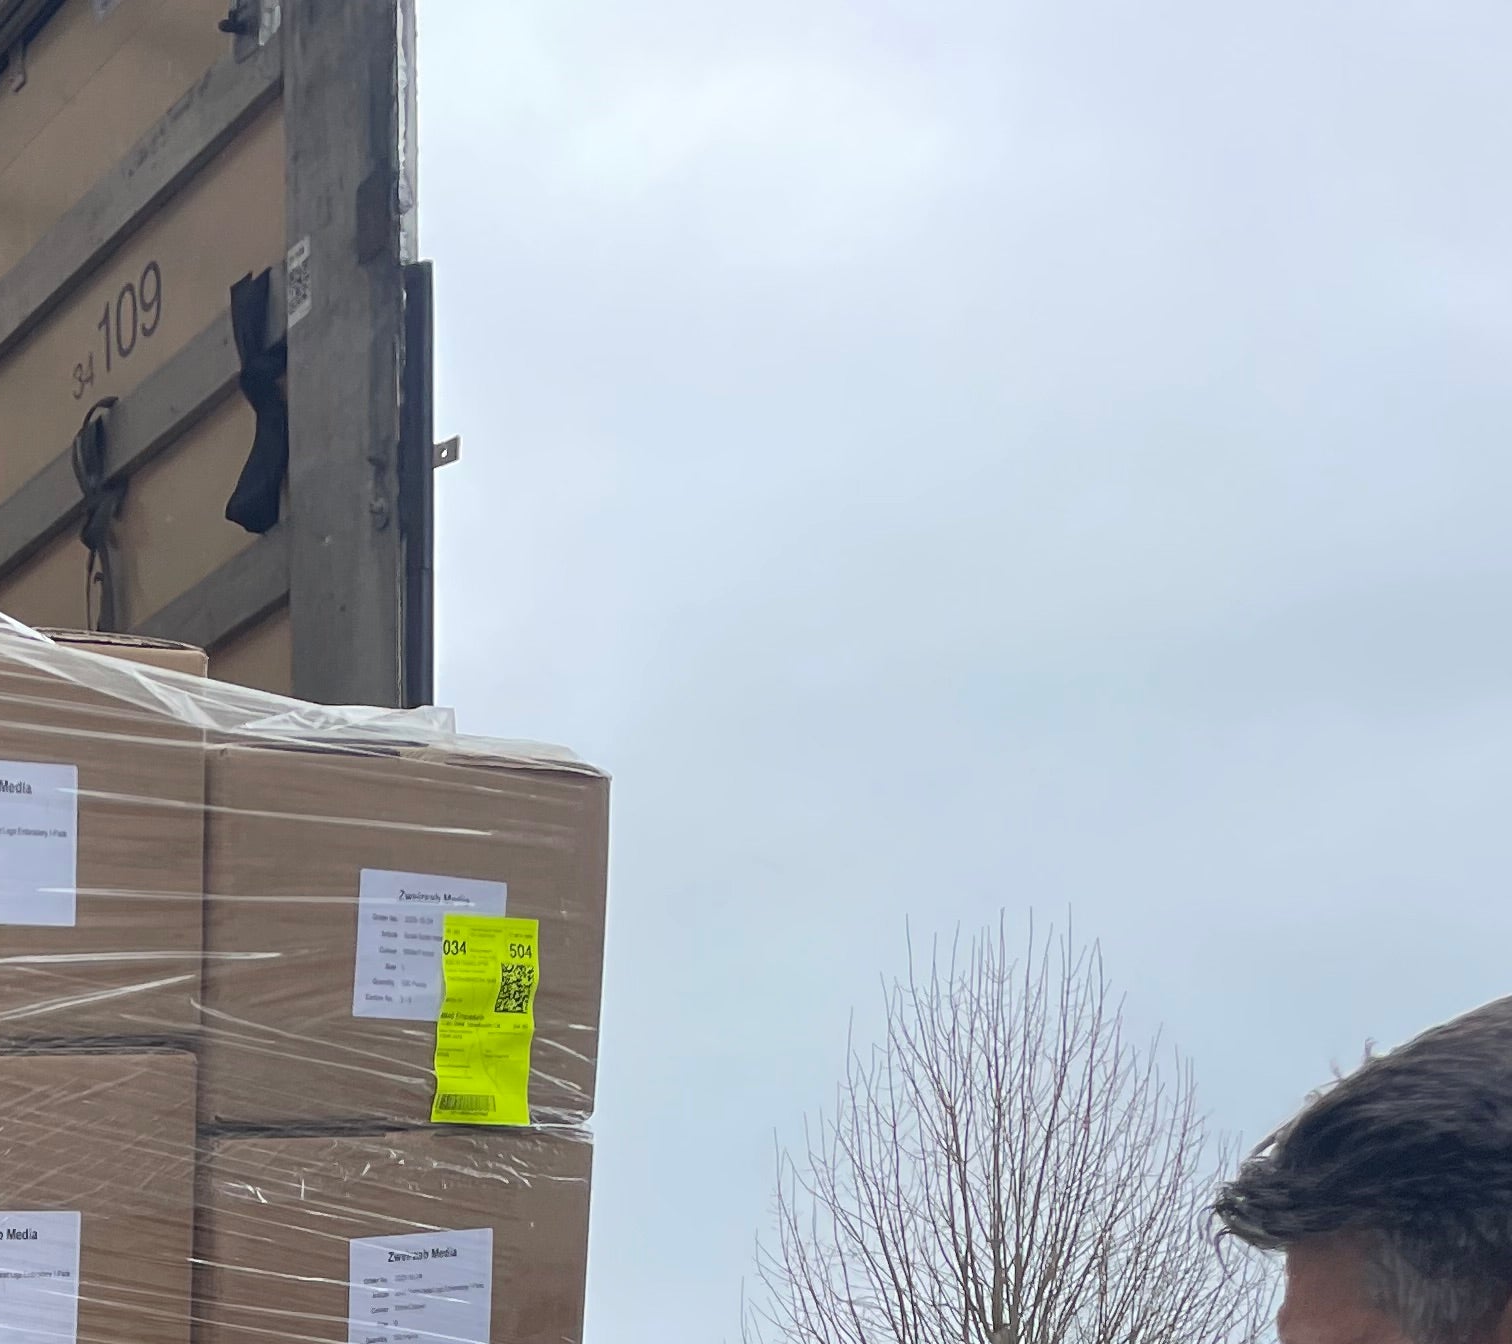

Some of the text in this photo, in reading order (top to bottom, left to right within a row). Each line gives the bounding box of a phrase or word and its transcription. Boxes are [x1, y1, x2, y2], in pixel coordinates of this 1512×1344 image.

[99, 260, 162, 373] 109
[443, 939, 466, 955] 034
[509, 943, 532, 959] 504
[5, 1228, 37, 1240] Media
